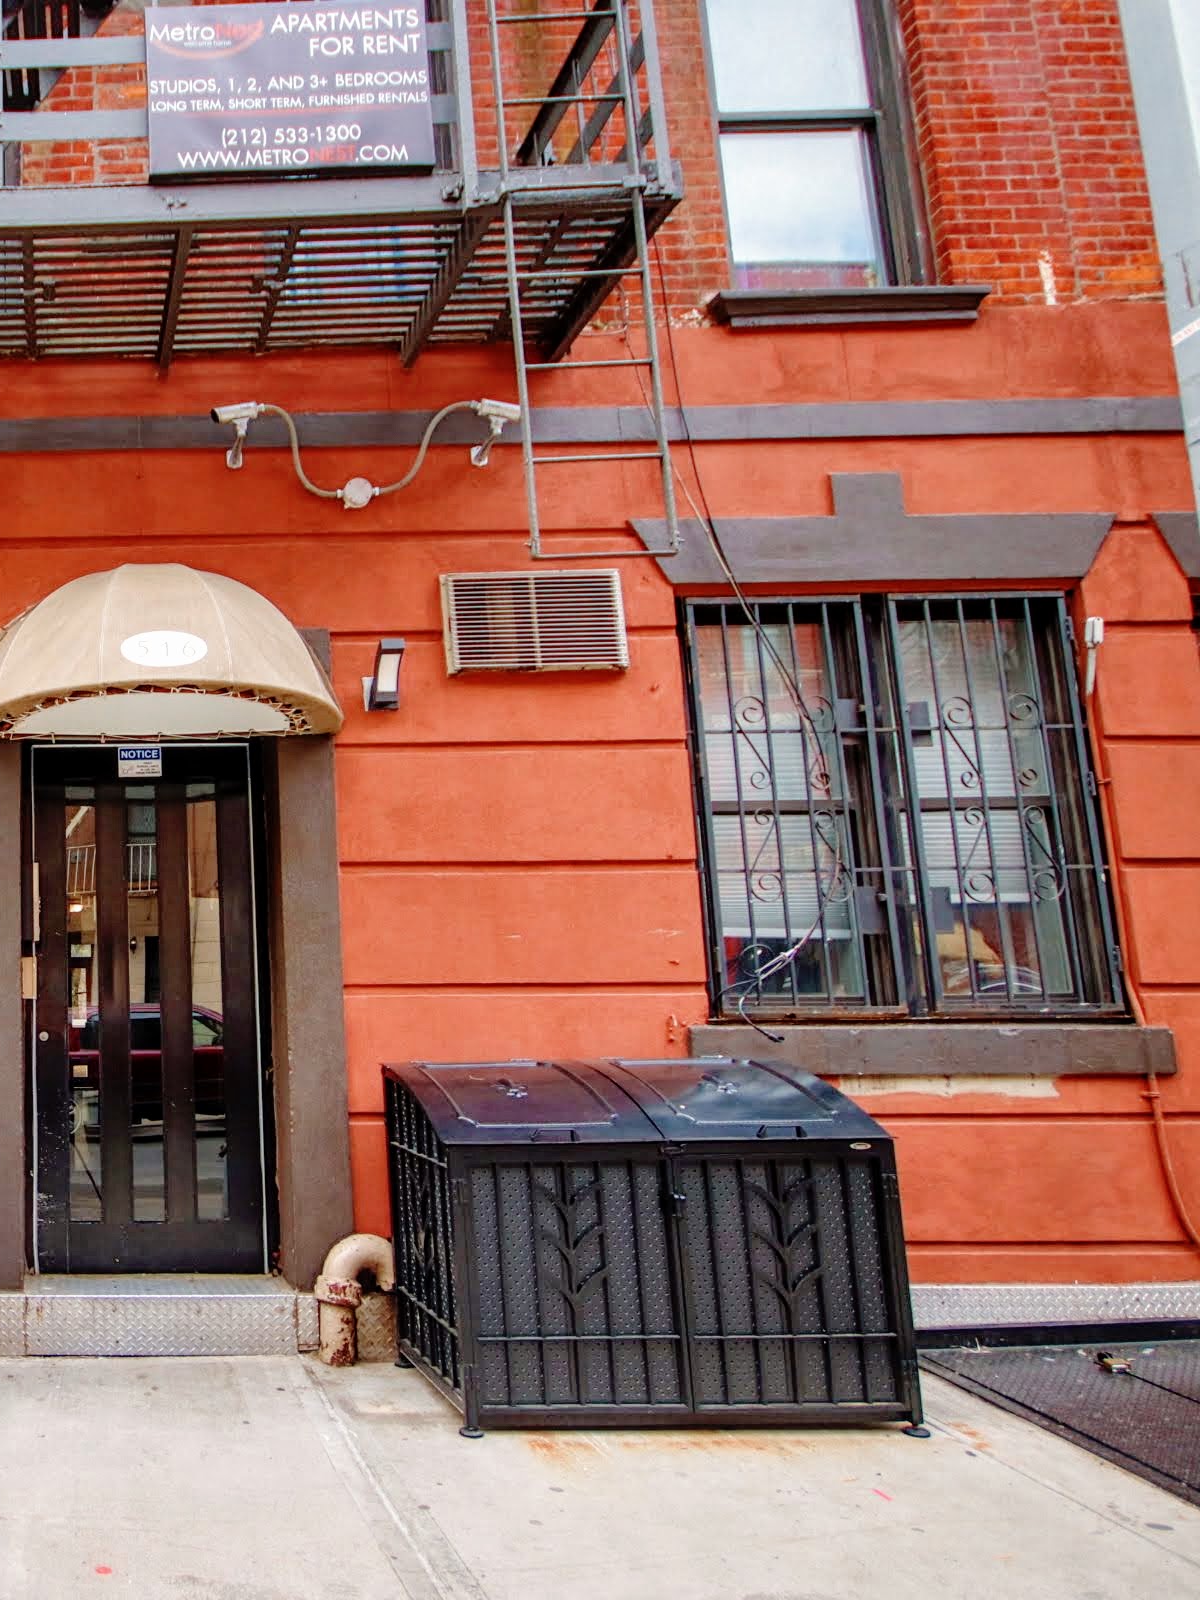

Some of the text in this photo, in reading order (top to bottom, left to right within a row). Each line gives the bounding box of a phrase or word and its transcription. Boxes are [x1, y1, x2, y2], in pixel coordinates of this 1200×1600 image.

[270, 9, 420, 34] APARTMENTS
[310, 34, 421, 56] FOR RENT
[150, 70, 427, 94] STUDIOS, 1, 2, AND 3+ BEDROOMS
[152, 91, 427, 112] LONG TERM, SHORT TERM, FURNISHED RENTALS
[222, 124, 361, 148] (212) 533-1300
[121, 750, 159, 759] NOTICE
